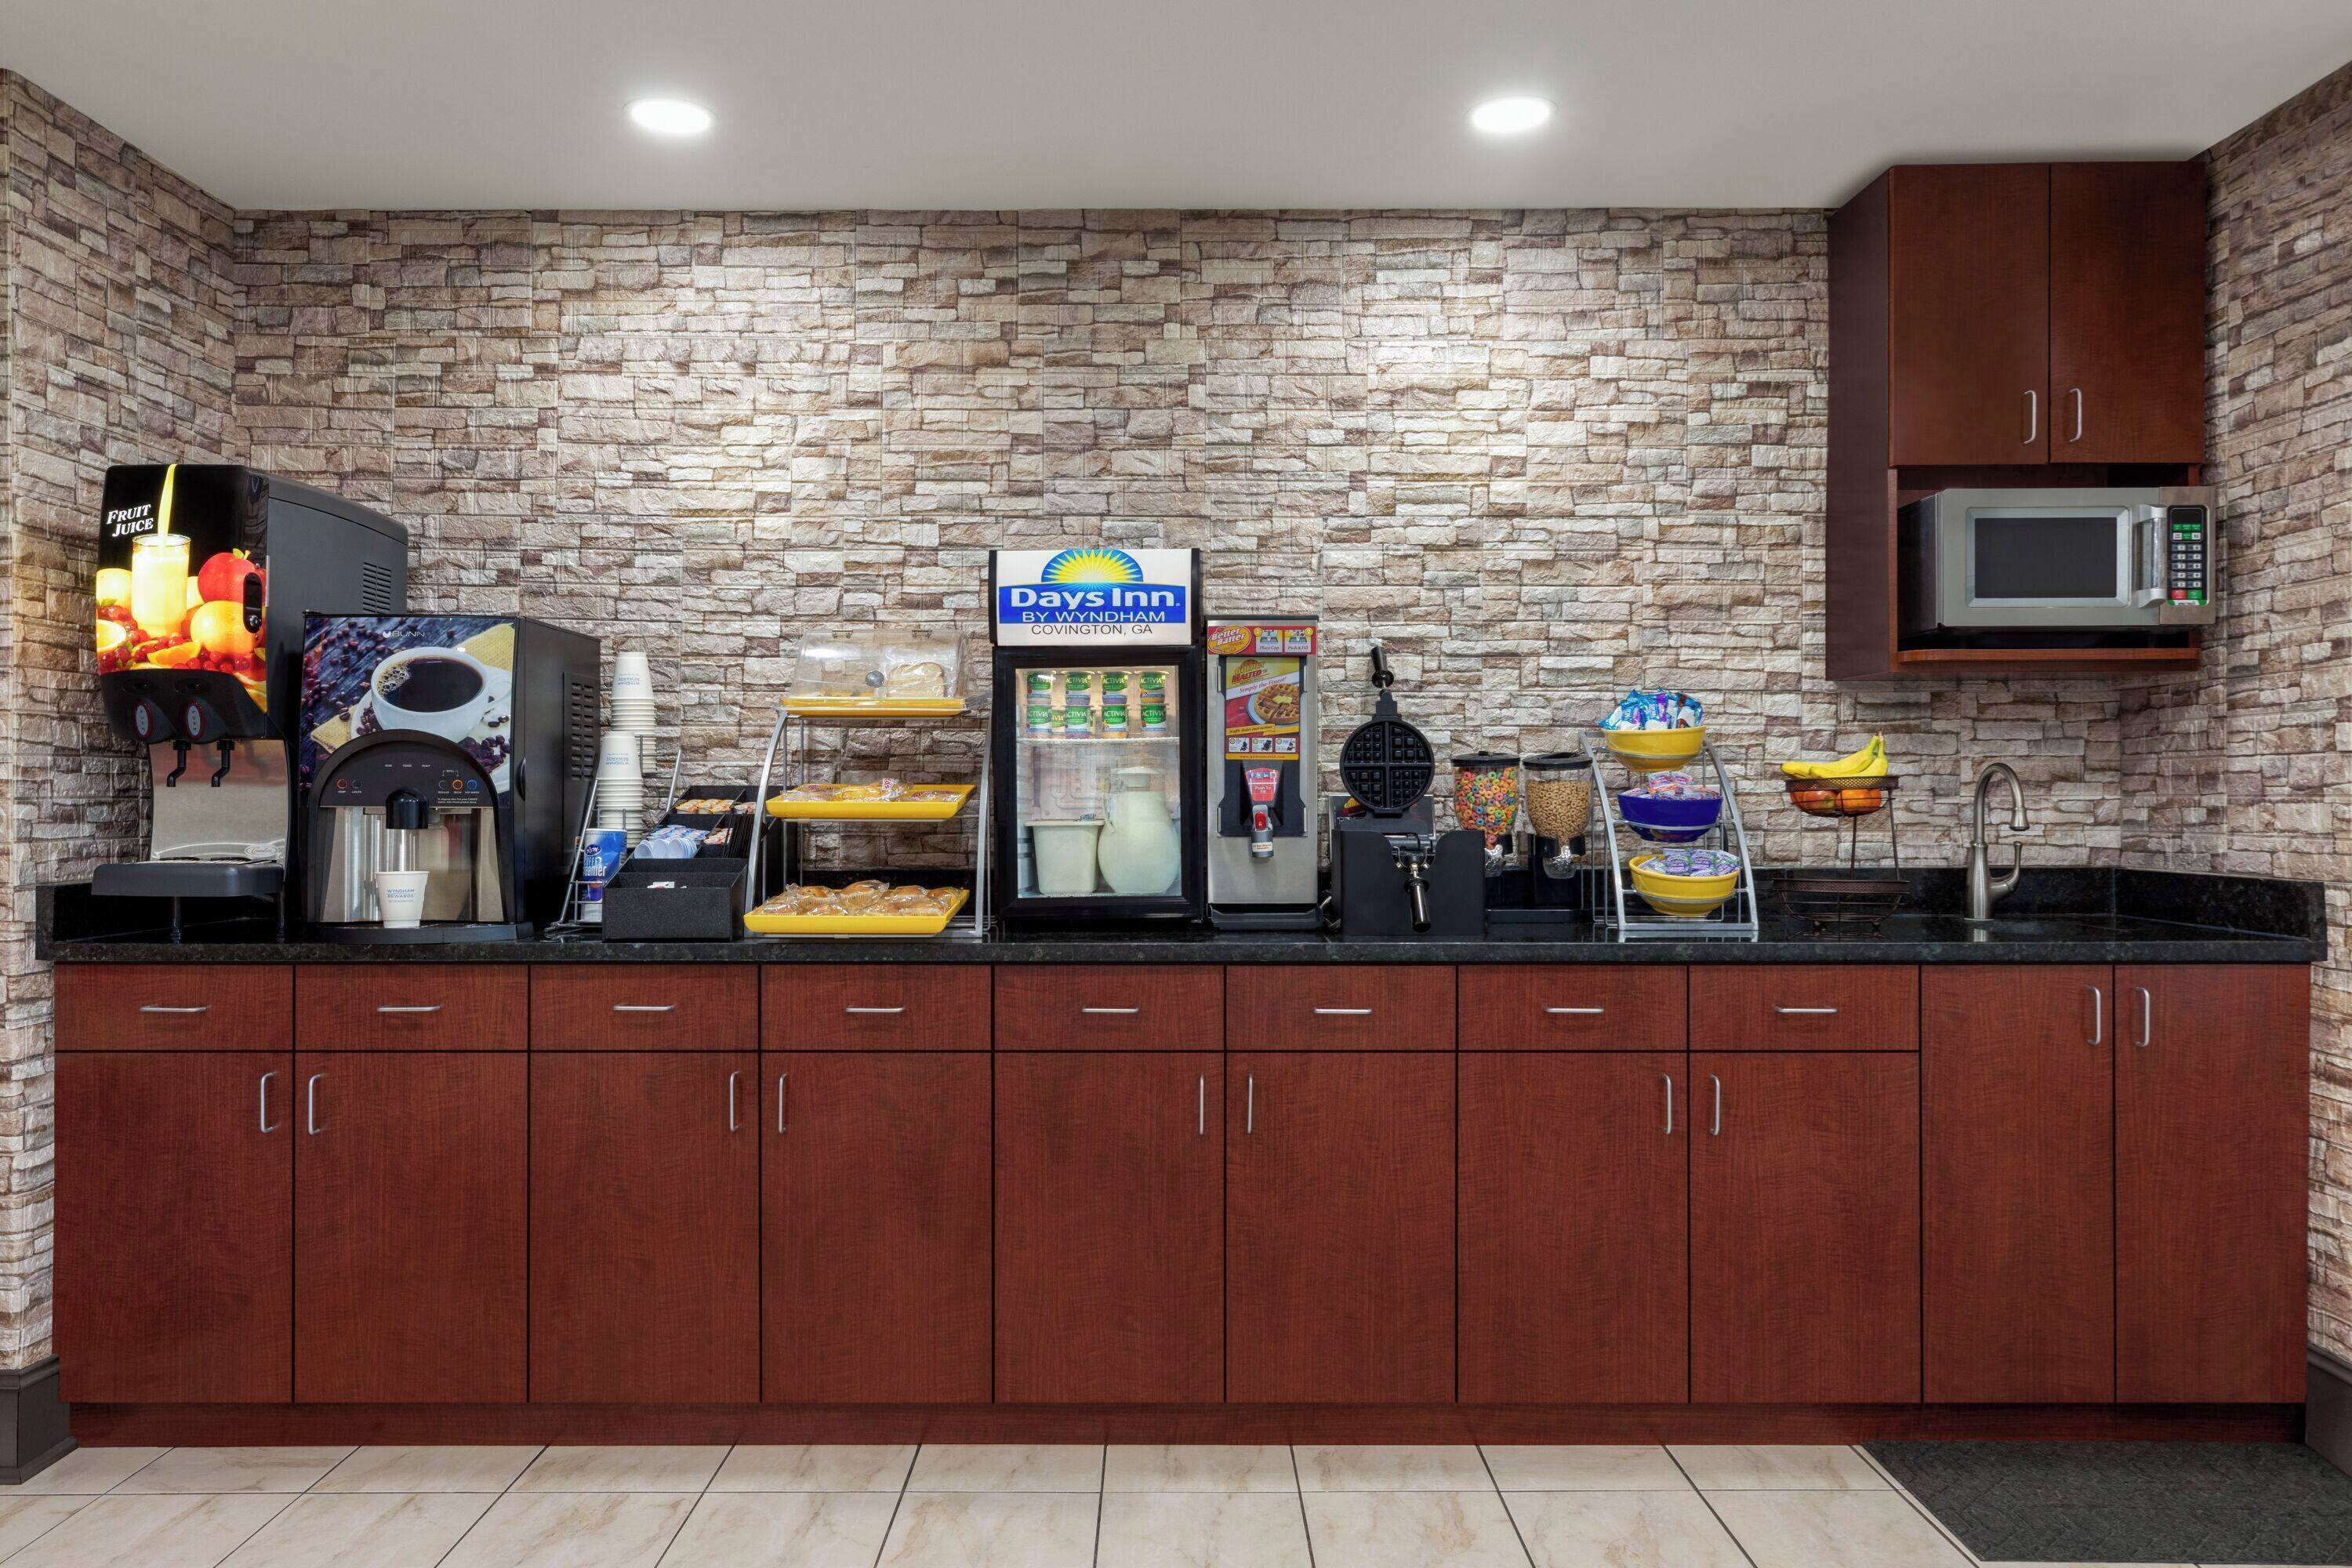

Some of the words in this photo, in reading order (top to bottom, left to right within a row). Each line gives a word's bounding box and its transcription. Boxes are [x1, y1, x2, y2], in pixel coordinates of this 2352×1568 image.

[106, 504, 151, 524] FRUIT
[112, 517, 154, 537] JUICE
[1011, 588, 1104, 610] Days
[1112, 588, 1175, 607] Inn
[1022, 611, 1050, 622] BY
[1054, 611, 1165, 622] WYNDHAM
[1031, 624, 1127, 636] COVINGTON,
[1131, 624, 1153, 634] GA
[1211, 628, 1240, 641] Better
[1239, 684, 1258, 693] Simply
